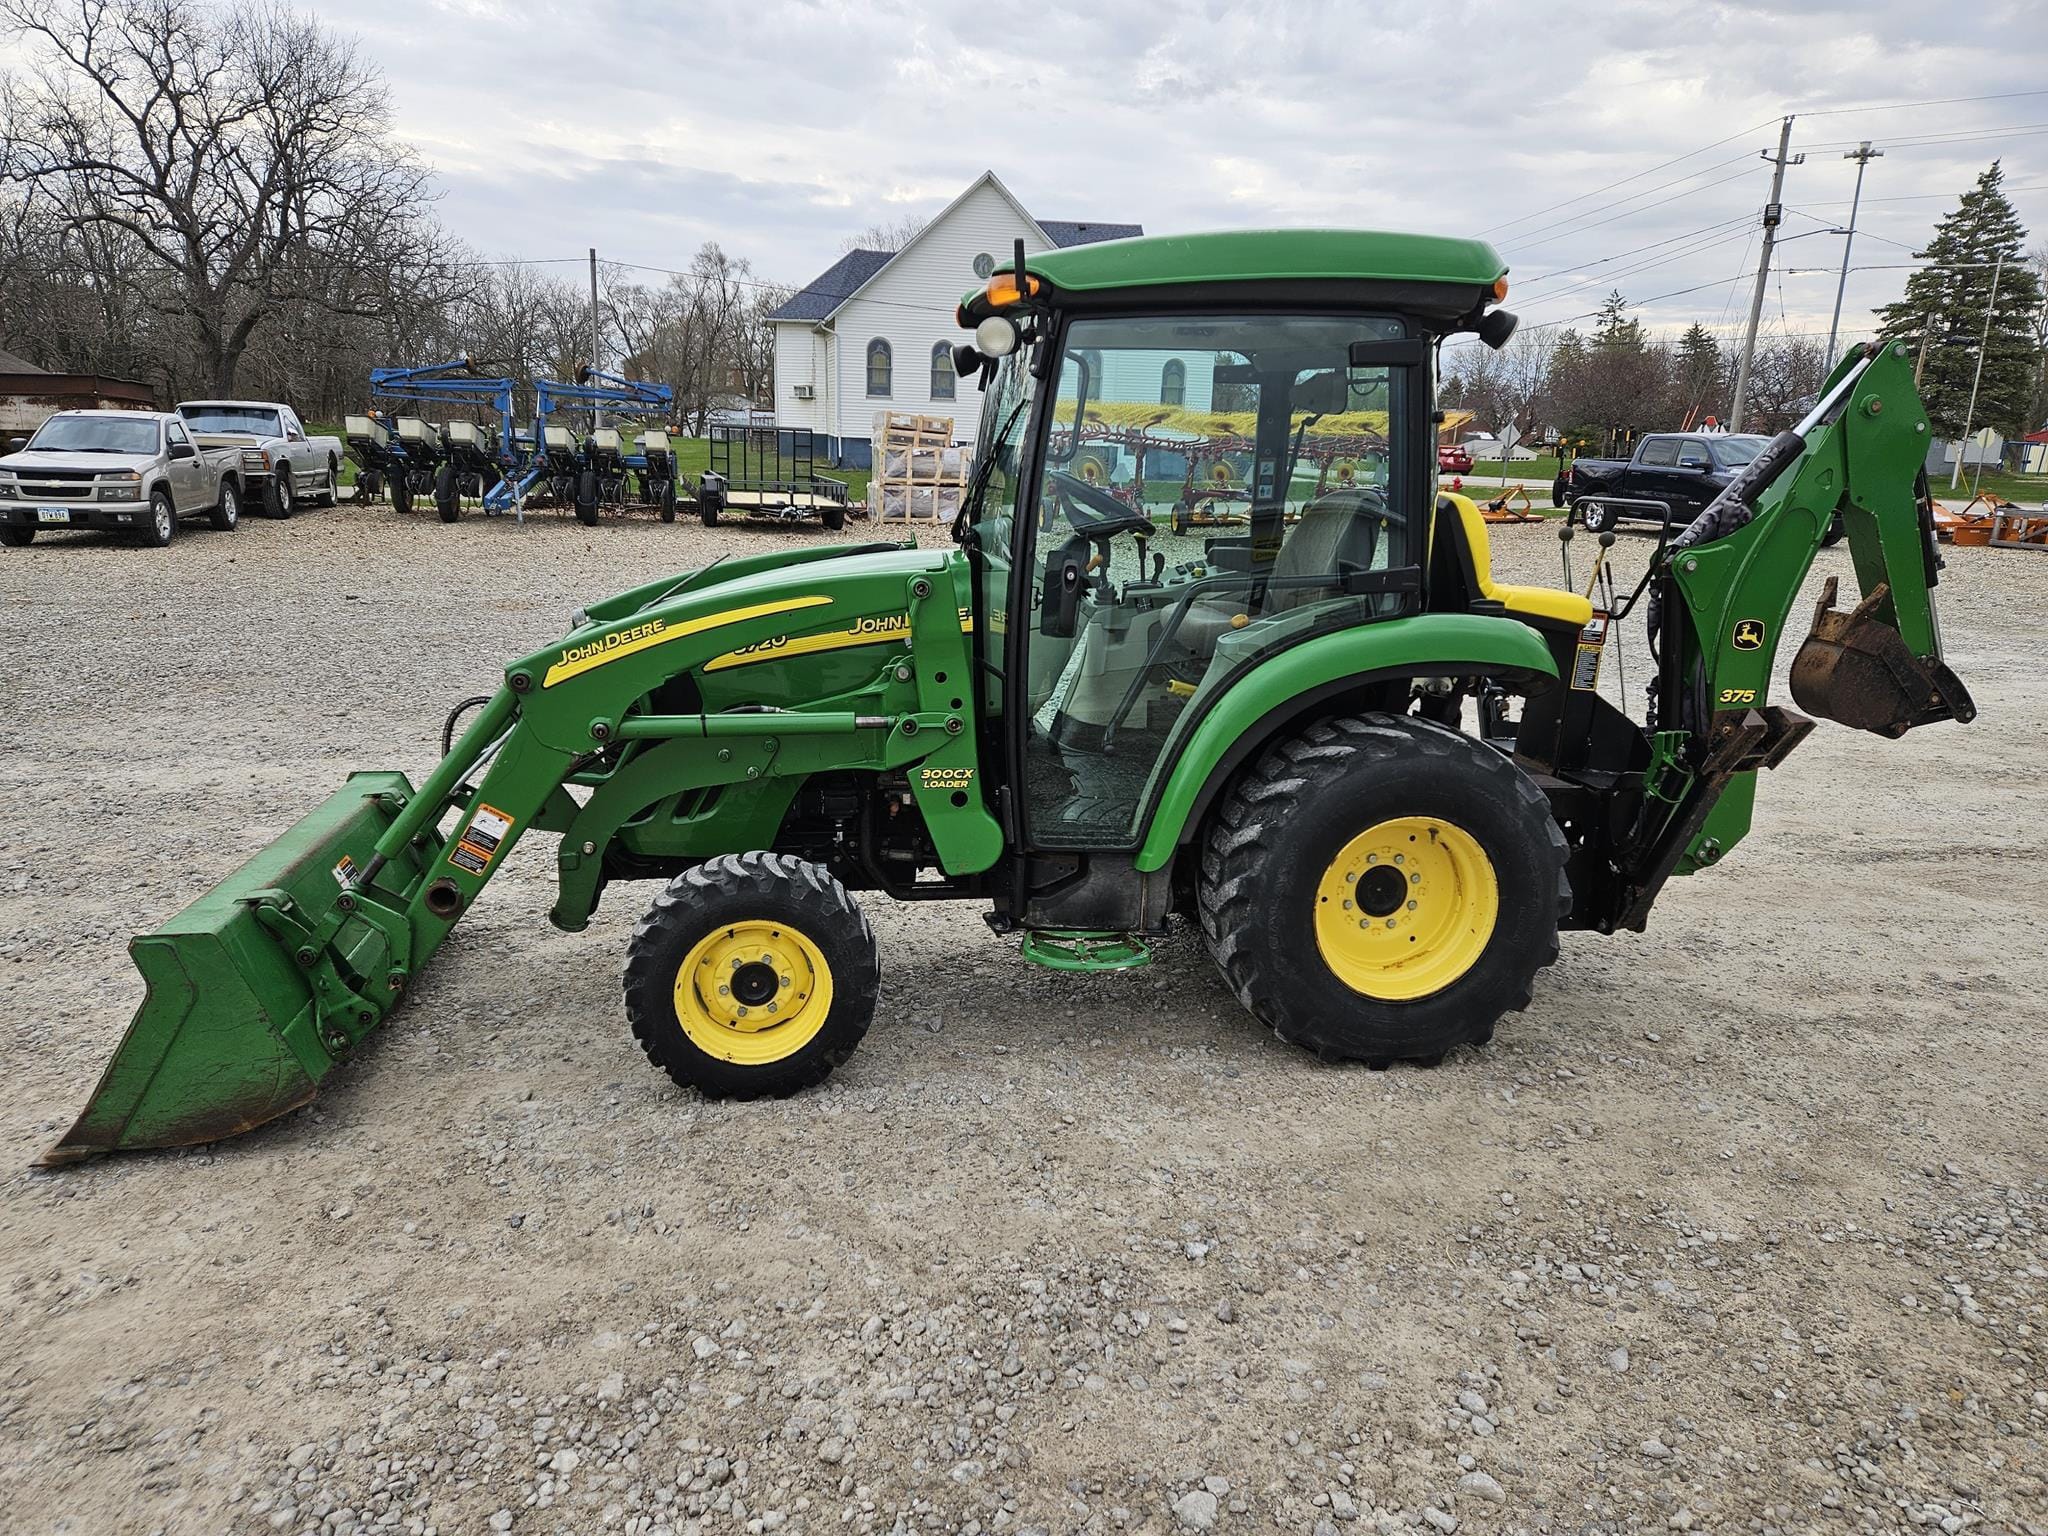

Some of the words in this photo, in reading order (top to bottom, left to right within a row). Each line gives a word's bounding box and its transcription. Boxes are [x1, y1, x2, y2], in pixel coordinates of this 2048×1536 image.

[848, 615, 902, 634] JOHN
[557, 639, 604, 667] JOHN
[605, 619, 666, 649] DEERE
[1720, 689, 1756, 703] 375
[921, 769, 975, 779] 300CX
[924, 780, 969, 788] LOADER
